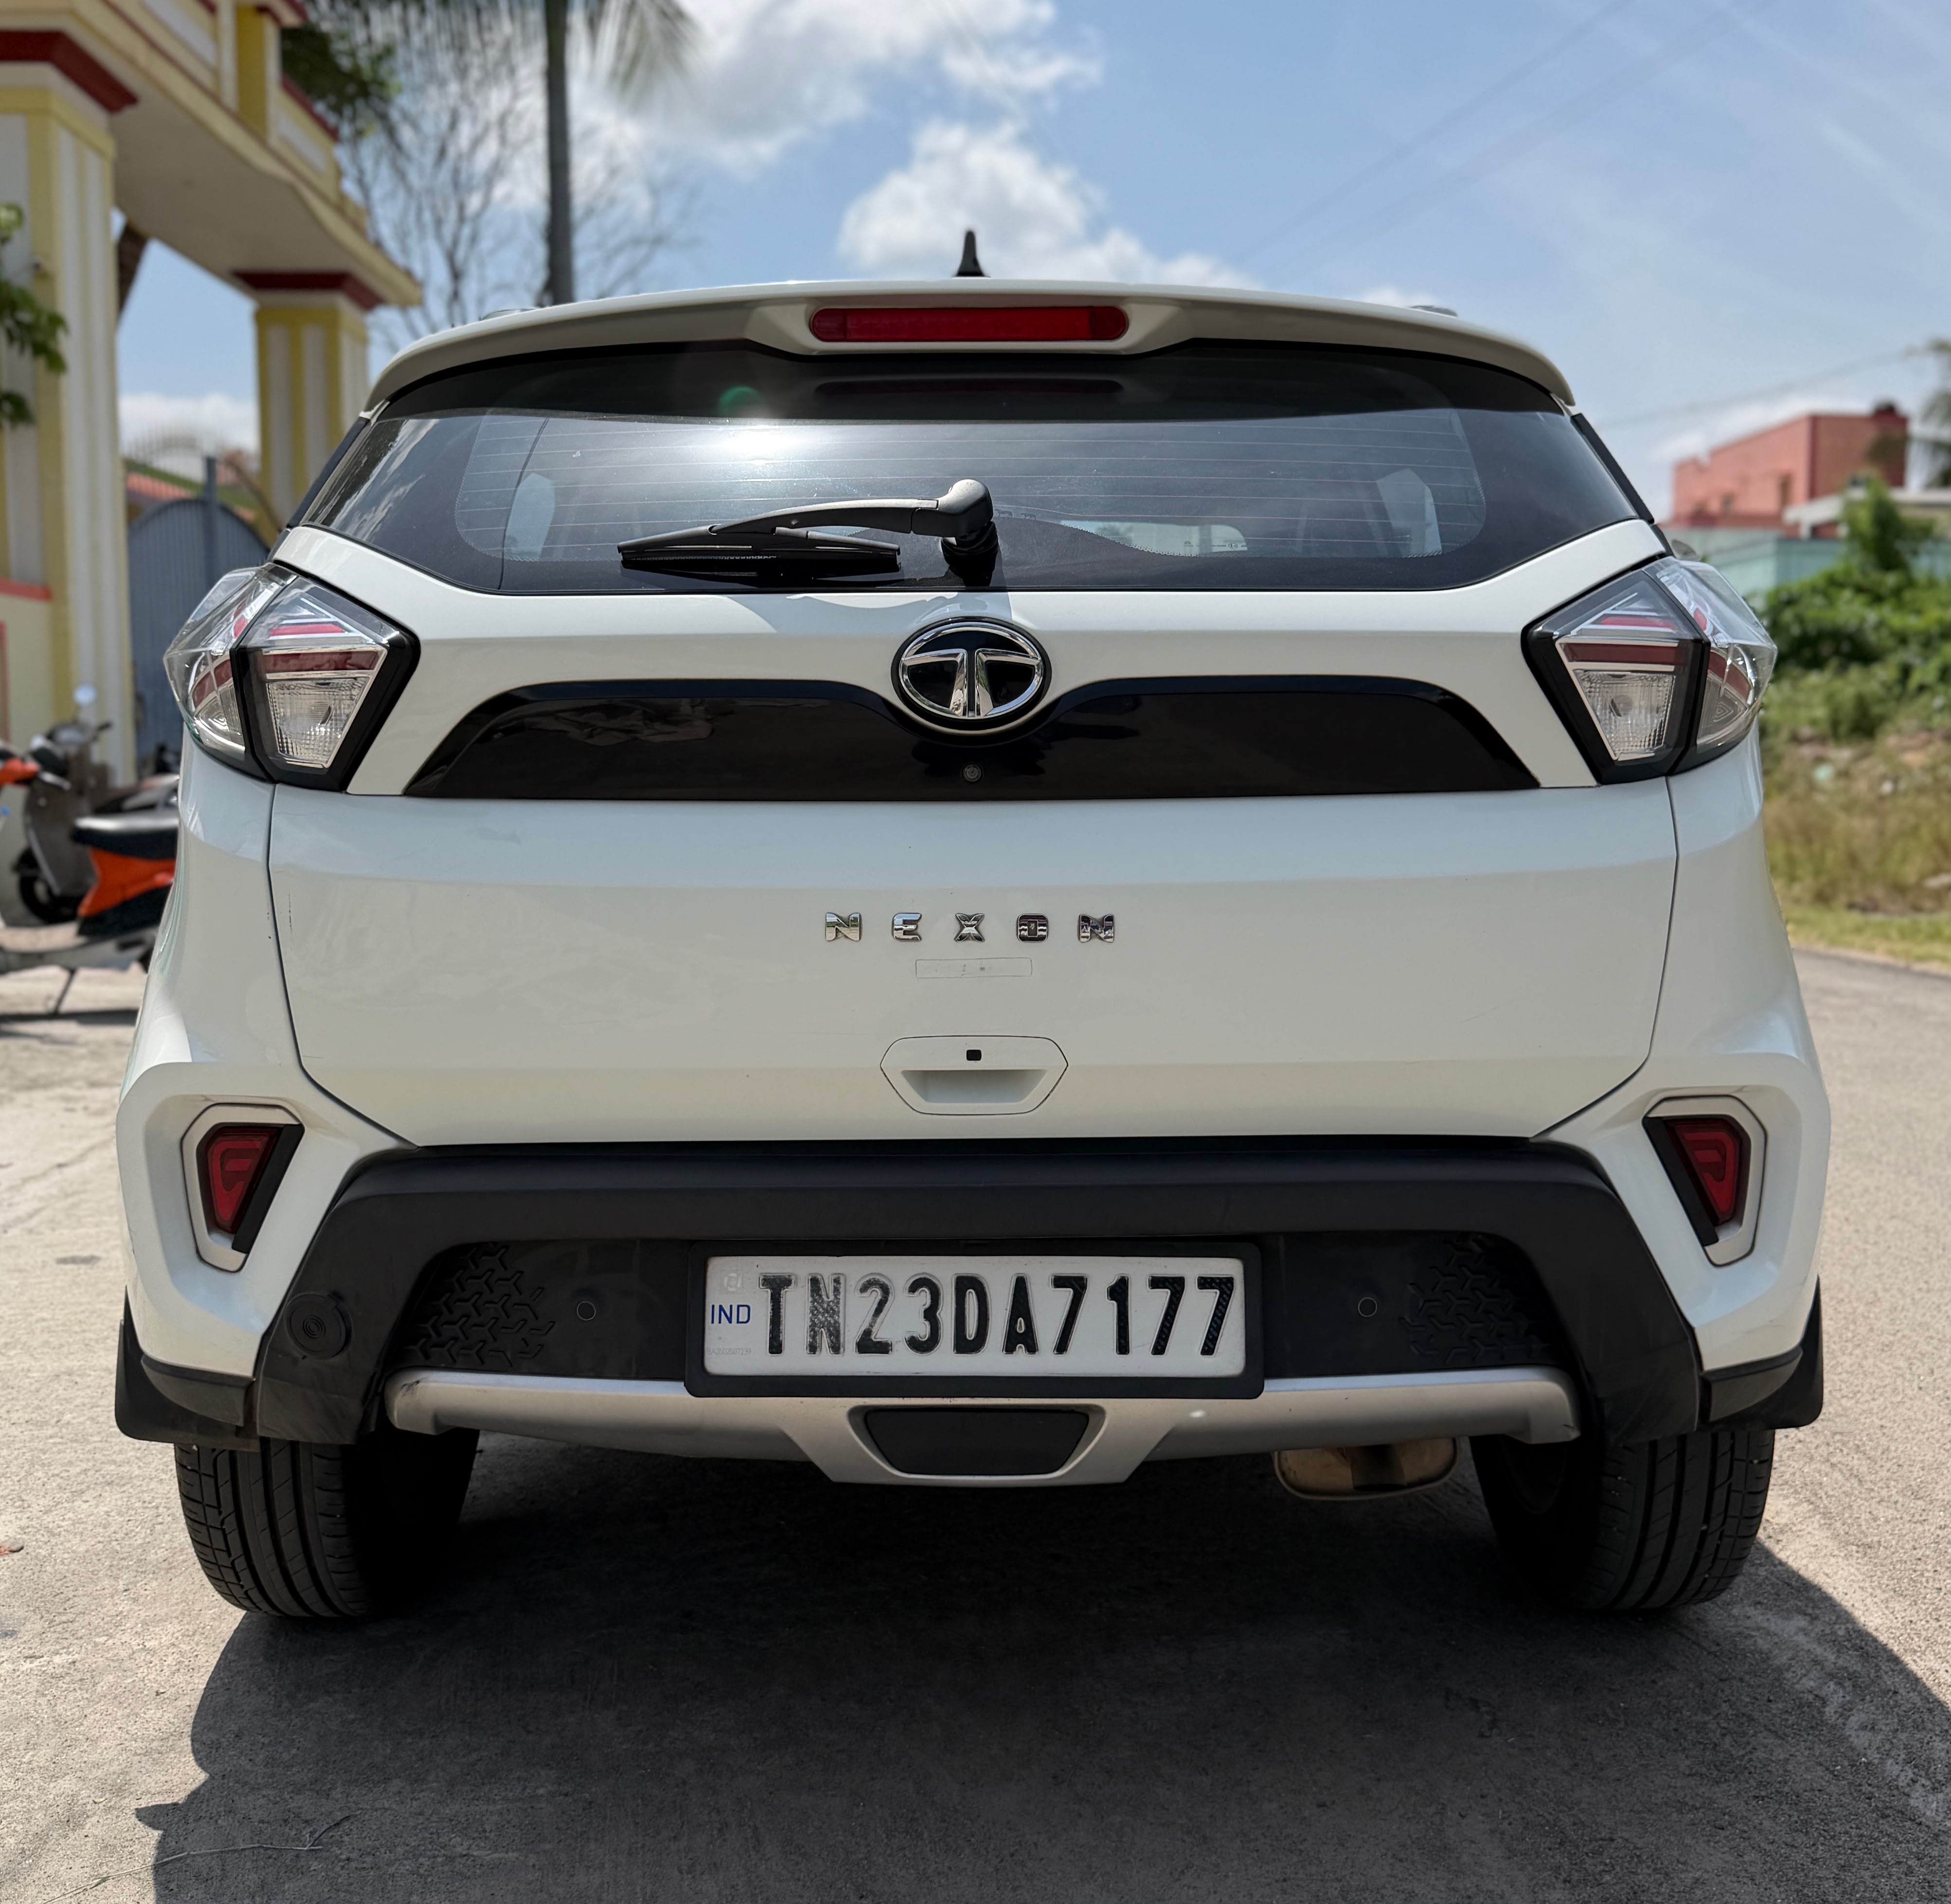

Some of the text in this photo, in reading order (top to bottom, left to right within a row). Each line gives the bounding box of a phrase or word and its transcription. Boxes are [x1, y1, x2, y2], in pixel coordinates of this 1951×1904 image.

[825, 912, 1114, 943] NEXON
[711, 1304, 751, 1324] IND
[758, 1272, 1235, 1356] TN23DA7177
